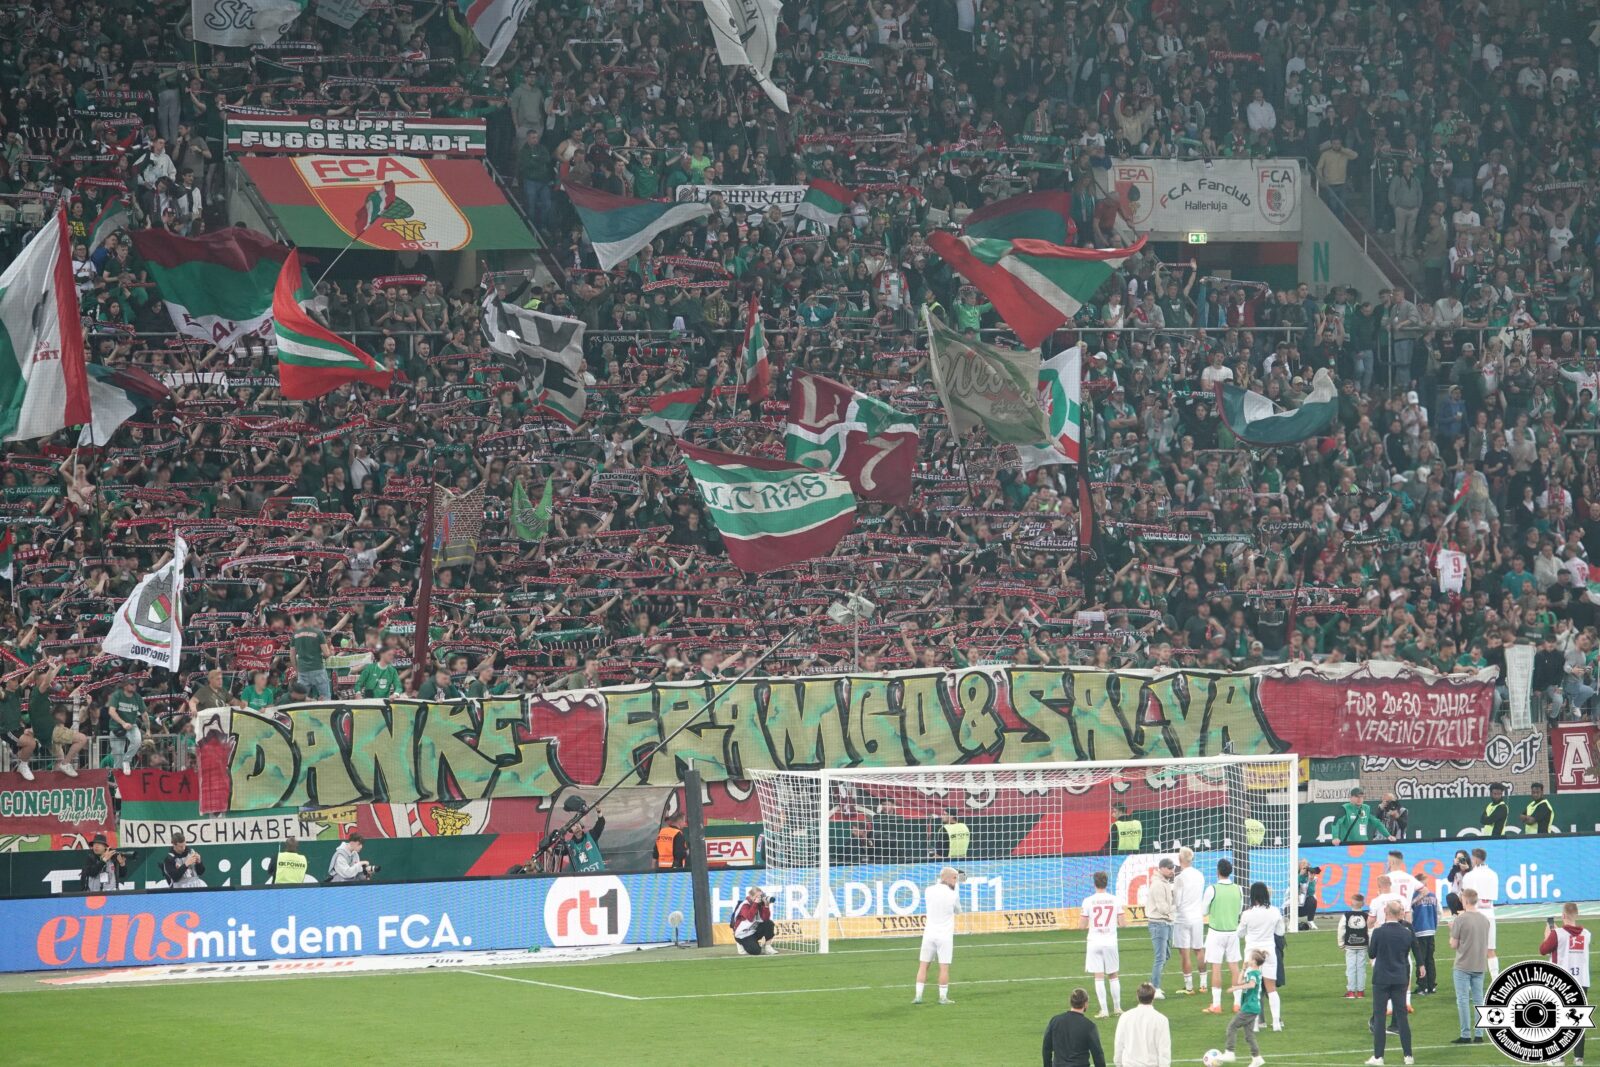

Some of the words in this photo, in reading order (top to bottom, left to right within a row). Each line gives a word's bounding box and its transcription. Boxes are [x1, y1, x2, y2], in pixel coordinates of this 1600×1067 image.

[310, 118, 405, 132] GRUPPE
[241, 131, 471, 152] FUGGERSTADT
[310, 158, 419, 180] FCA
[1119, 168, 1149, 181] FCA
[1260, 170, 1292, 183] FCA
[1160, 182, 1192, 208] FCA
[1198, 178, 1251, 208] Fanclub
[1313, 241, 1330, 282] N
[1452, 557, 1461, 574] 9
[1346, 690, 1376, 716] FÜR
[1427, 693, 1476, 717] JAHRE
[228, 700, 558, 813] DANKE
[142, 772, 191, 794] FCA
[1, 787, 107, 817] CONCORDIA
[58, 806, 108, 826] Augsburg
[125, 818, 310, 846] NORDSCHWABEN
[706, 841, 749, 858] FCA
[1505, 863, 1562, 899] dir.
[557, 888, 618, 938] rt1
[1004, 910, 1057, 927] YTONG
[1093, 905, 1114, 928] 27
[37, 896, 200, 964] eins
[188, 918, 256, 958] mit
[271, 917, 362, 954] dem
[379, 912, 473, 949] FCA.
